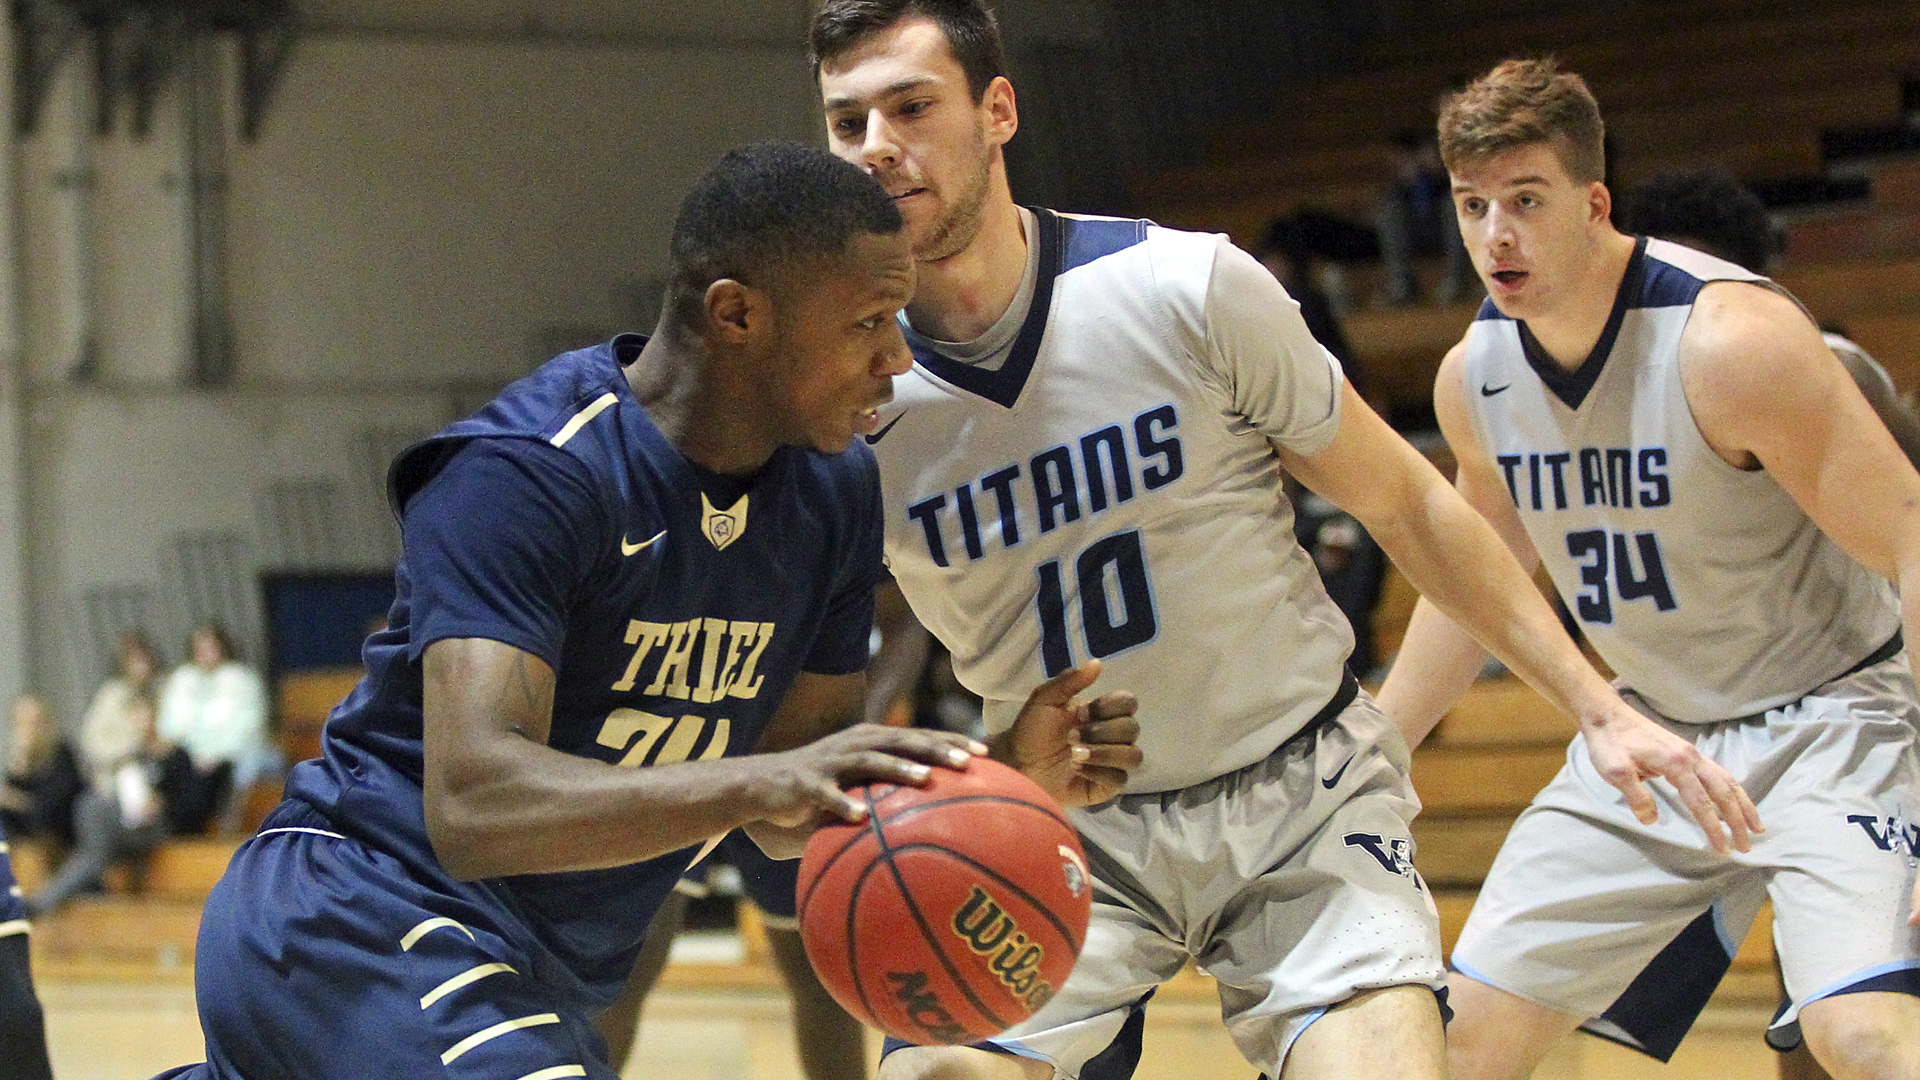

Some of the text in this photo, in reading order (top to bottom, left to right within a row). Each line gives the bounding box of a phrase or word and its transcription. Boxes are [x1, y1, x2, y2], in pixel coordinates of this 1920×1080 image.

[907, 403, 1185, 568] TITANS
[1496, 446, 1671, 511] TITANS
[1035, 527, 1162, 680] 10
[1565, 528, 1678, 625] 34
[610, 616, 776, 704] THIEL
